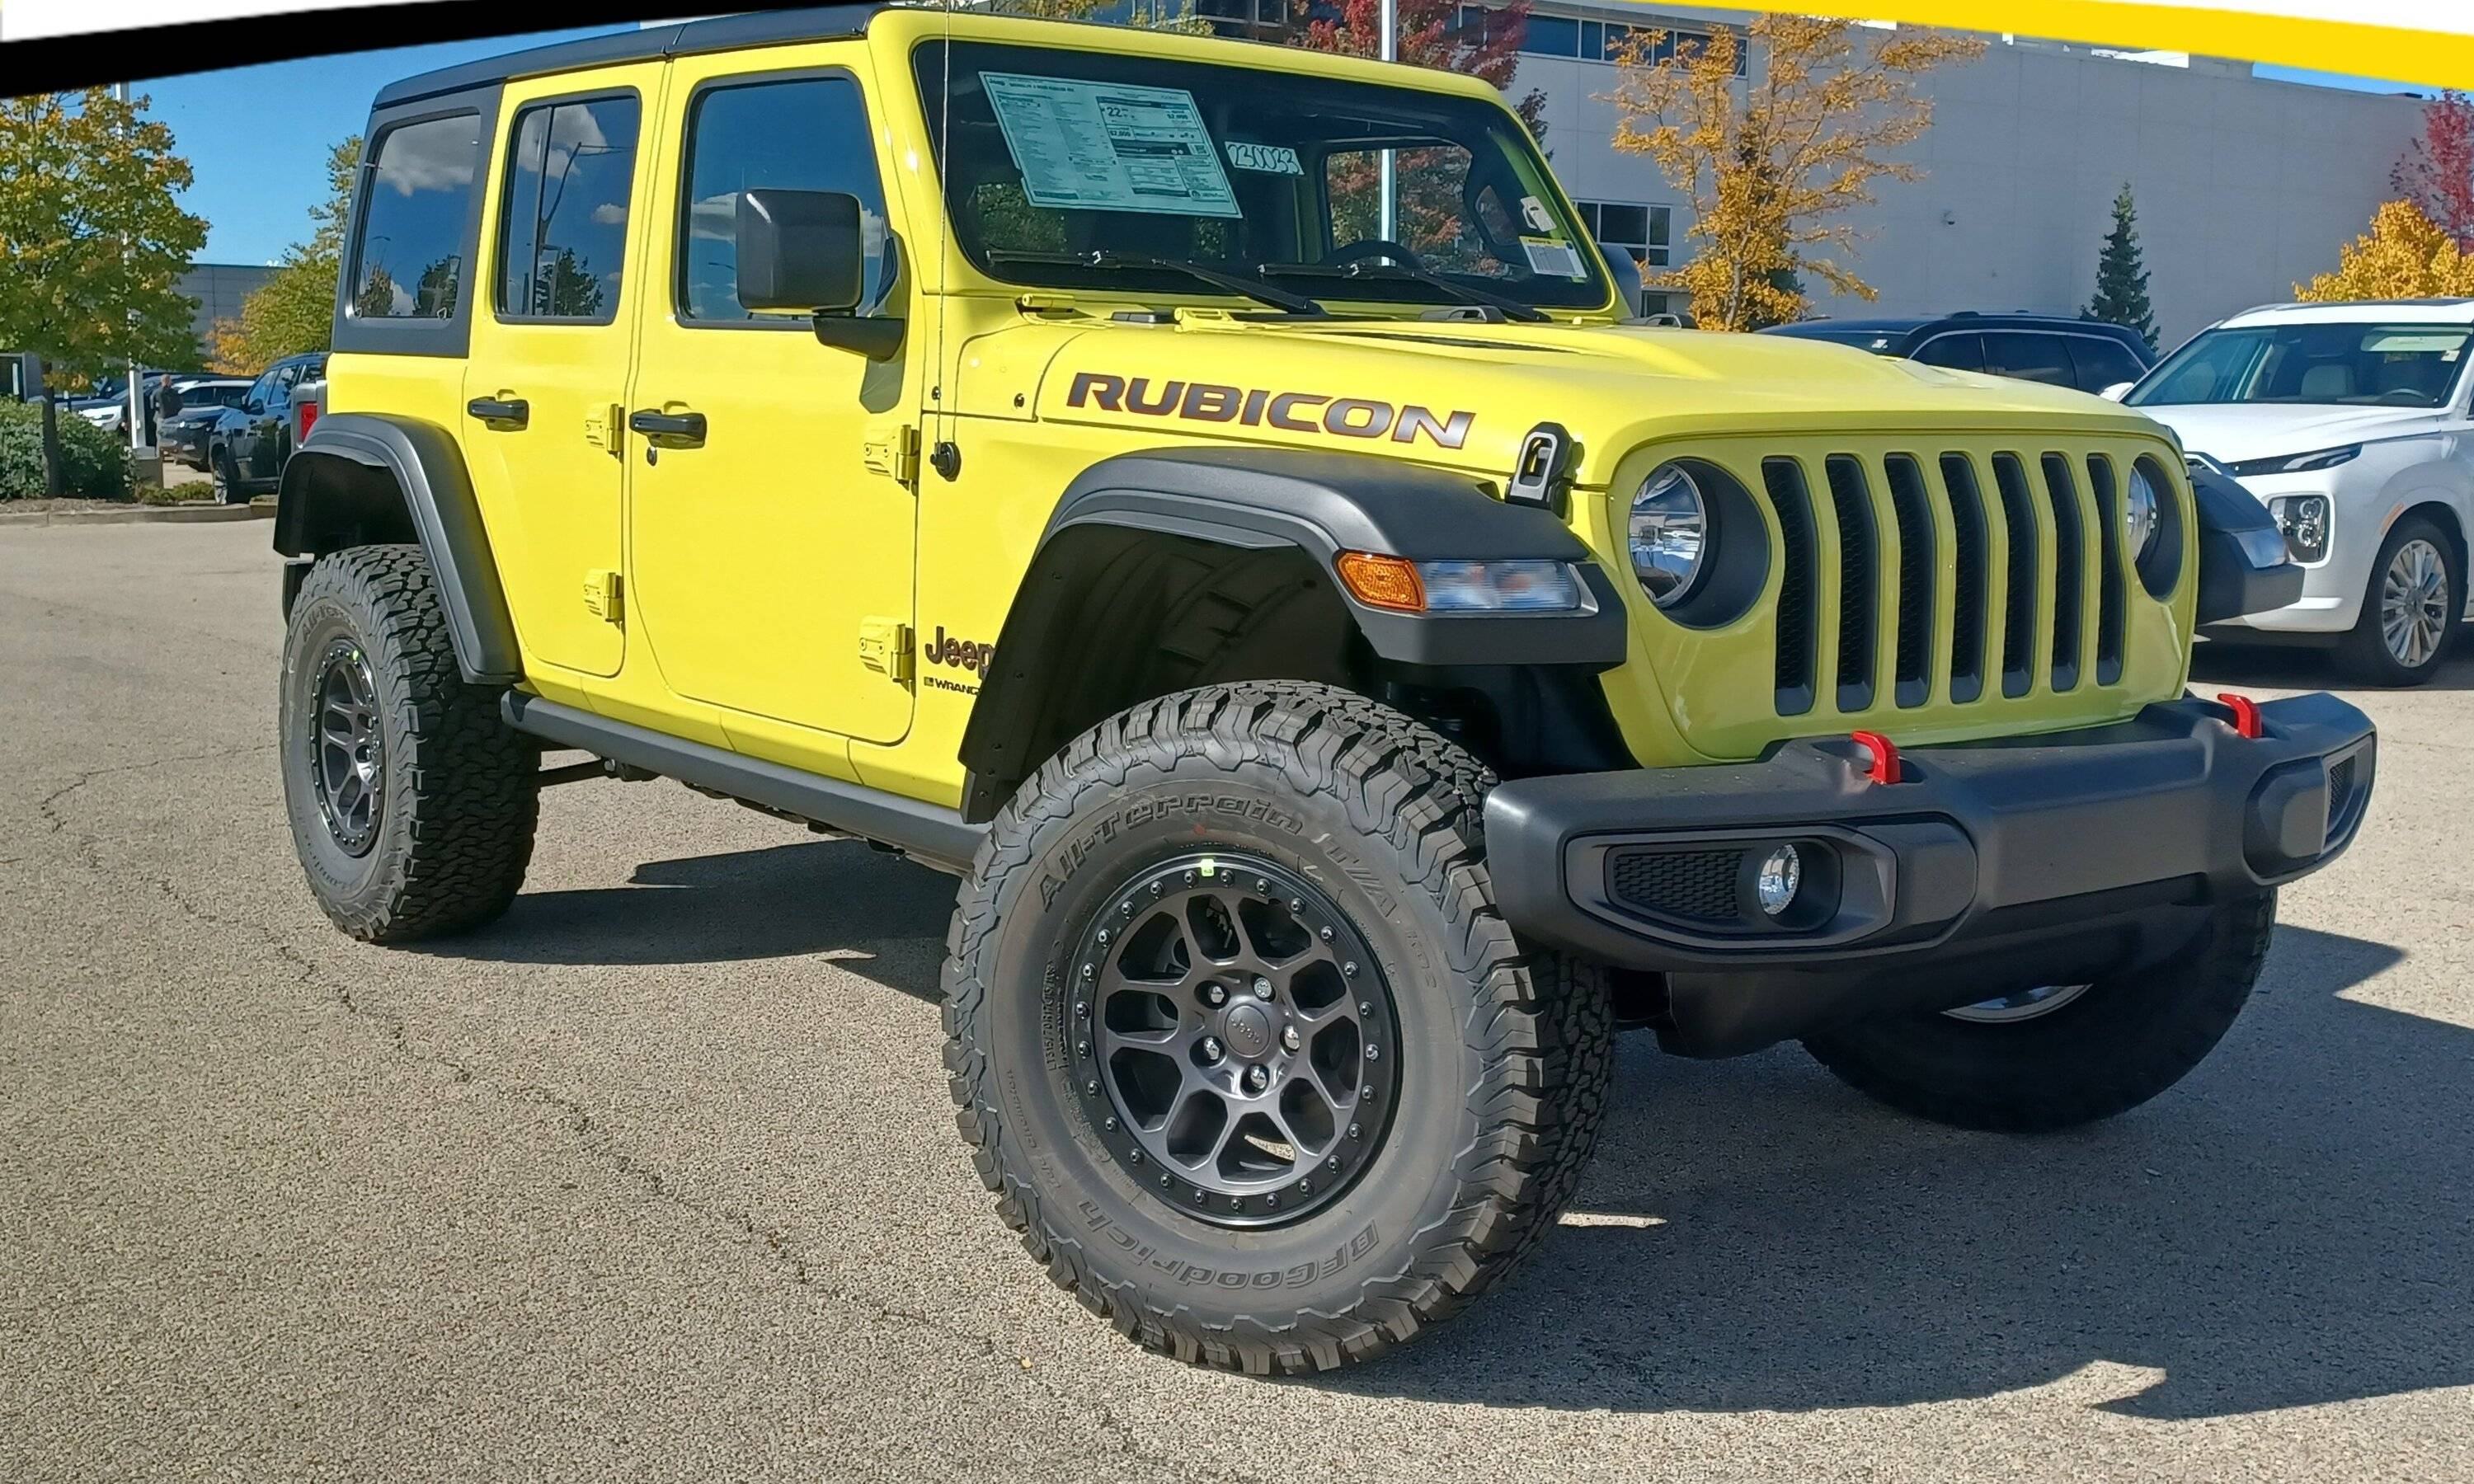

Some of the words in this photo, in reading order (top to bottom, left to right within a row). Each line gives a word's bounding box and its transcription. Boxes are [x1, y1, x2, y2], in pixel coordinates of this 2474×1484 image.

[1107, 106, 1122, 117] 22
[1228, 144, 1300, 174] 230033
[1066, 373, 1476, 449] RUBICON
[924, 625, 995, 681] Jeep
[1040, 792, 1304, 913] All-Terrain
[1078, 1200, 1380, 1289] BFGoodrich
